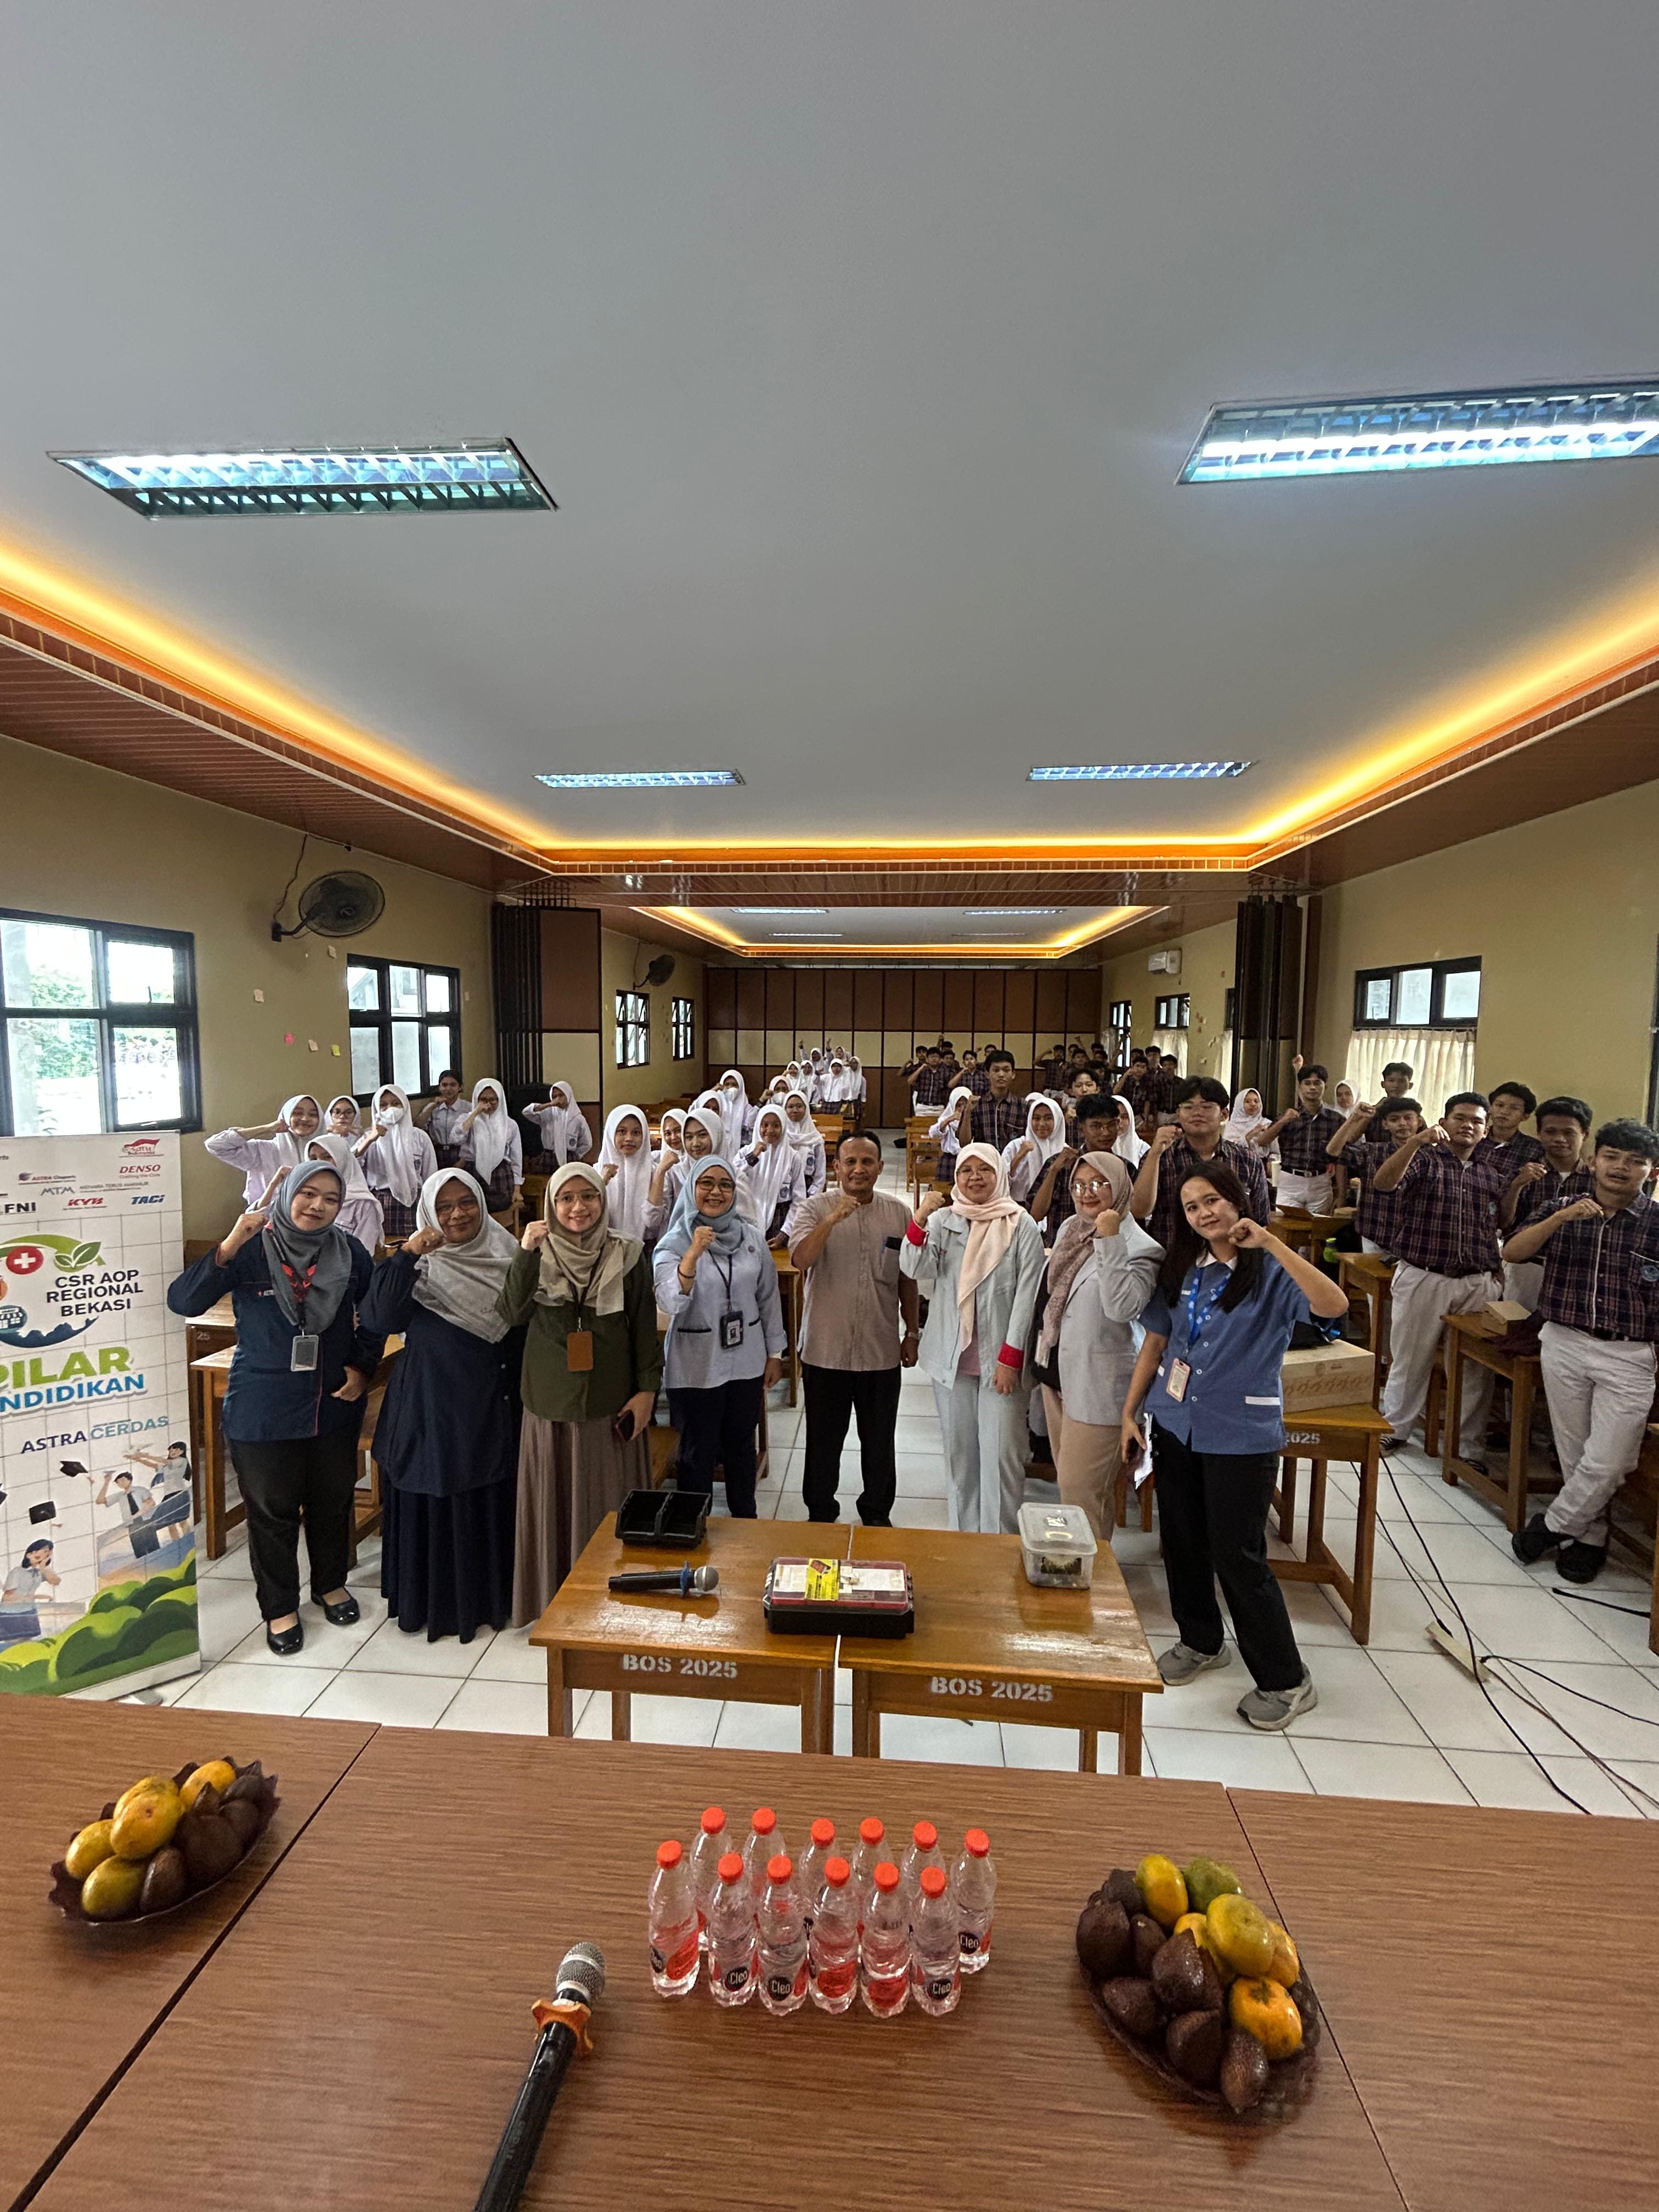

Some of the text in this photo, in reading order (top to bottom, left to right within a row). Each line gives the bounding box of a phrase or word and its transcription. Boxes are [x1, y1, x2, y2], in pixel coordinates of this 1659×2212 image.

[119, 1164, 161, 1173] DENSO
[40, 1187, 75, 1196] MTM
[4, 1202, 36, 1214] FNI
[67, 1197, 103, 1206] KYB
[55, 1269, 139, 1288] CSR AOP
[46, 1282, 144, 1303] REGIONAL
[60, 1298, 131, 1317] BEKASI
[0, 1374, 144, 1413] NDIDIKAN
[21, 1415, 169, 1454] ASTRA CERDAS
[623, 1654, 737, 1679] BOS 2025
[931, 1676, 1053, 1702] BOS 2025
[960, 1934, 979, 1949] Cleo
[730, 1971, 747, 1985] Cleo
[771, 1980, 791, 1994] Cleo
[932, 1982, 951, 1995] Cleo
